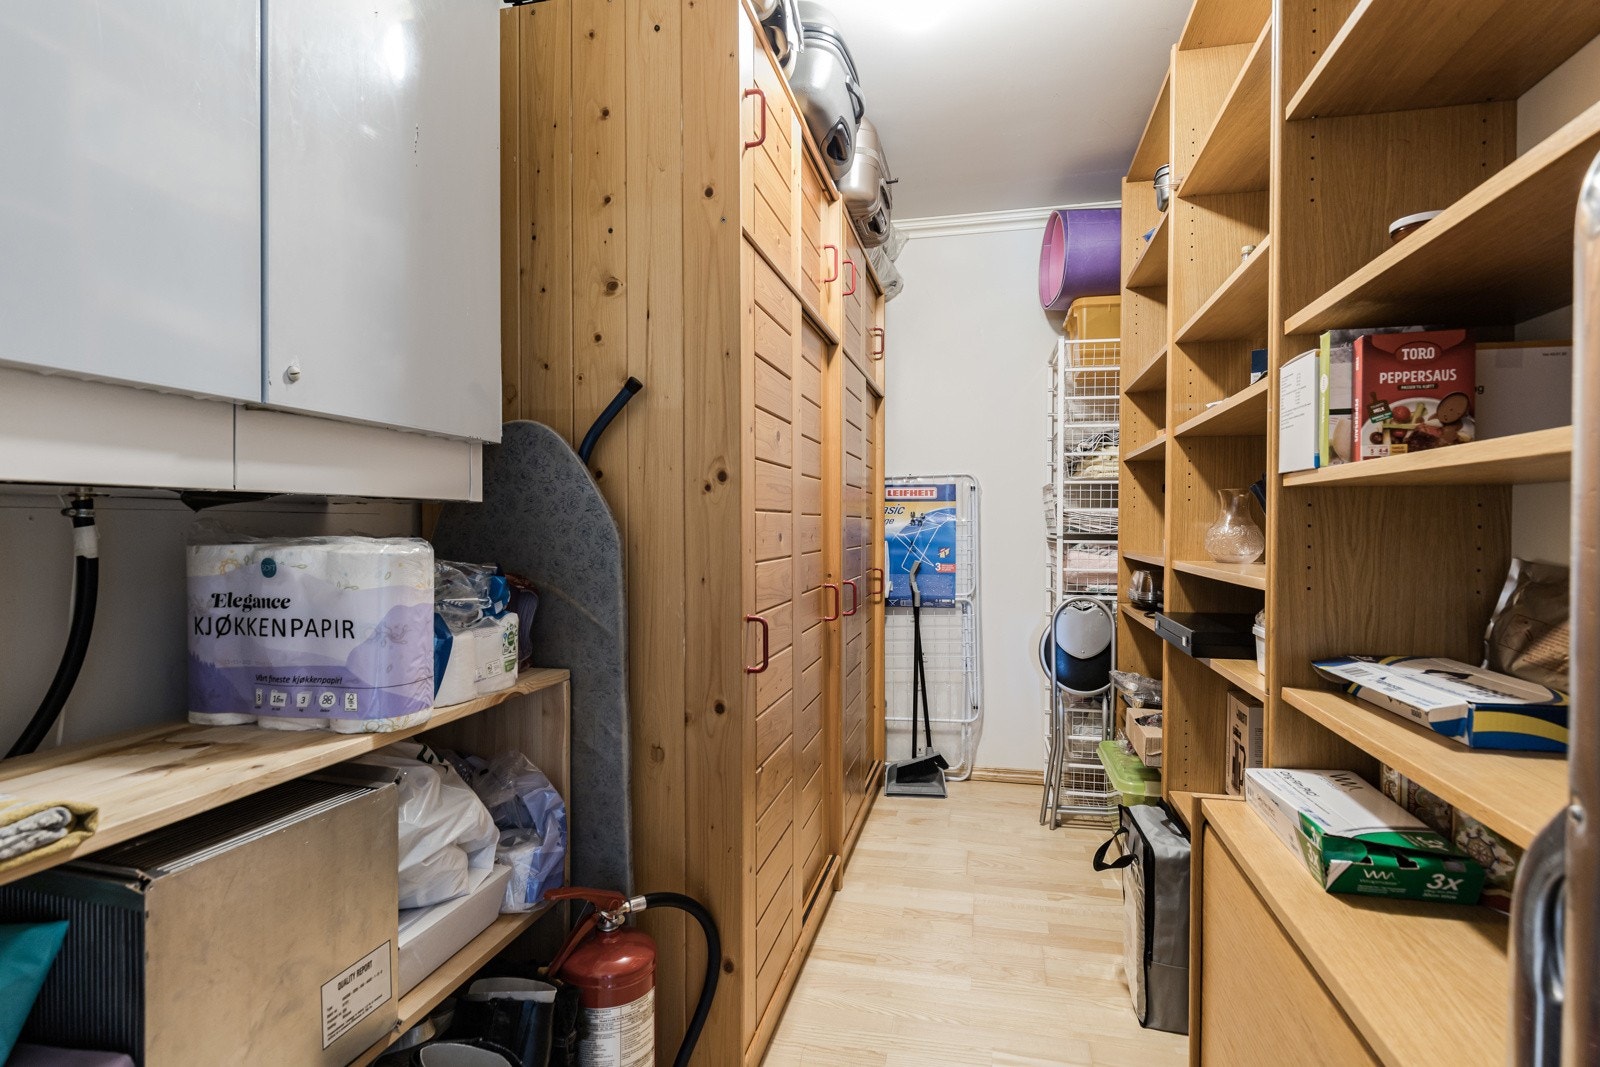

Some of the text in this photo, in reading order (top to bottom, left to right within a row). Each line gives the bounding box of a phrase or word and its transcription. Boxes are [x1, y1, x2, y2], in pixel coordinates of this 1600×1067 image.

[1402, 347, 1435, 360] TORO
[1379, 369, 1457, 384] PEPPERSAUS
[887, 489, 935, 497] LEIFHEIT
[935, 562, 941, 571] 3
[211, 592, 291, 612] Elegance
[194, 614, 355, 639] KJØKKENPAPIR
